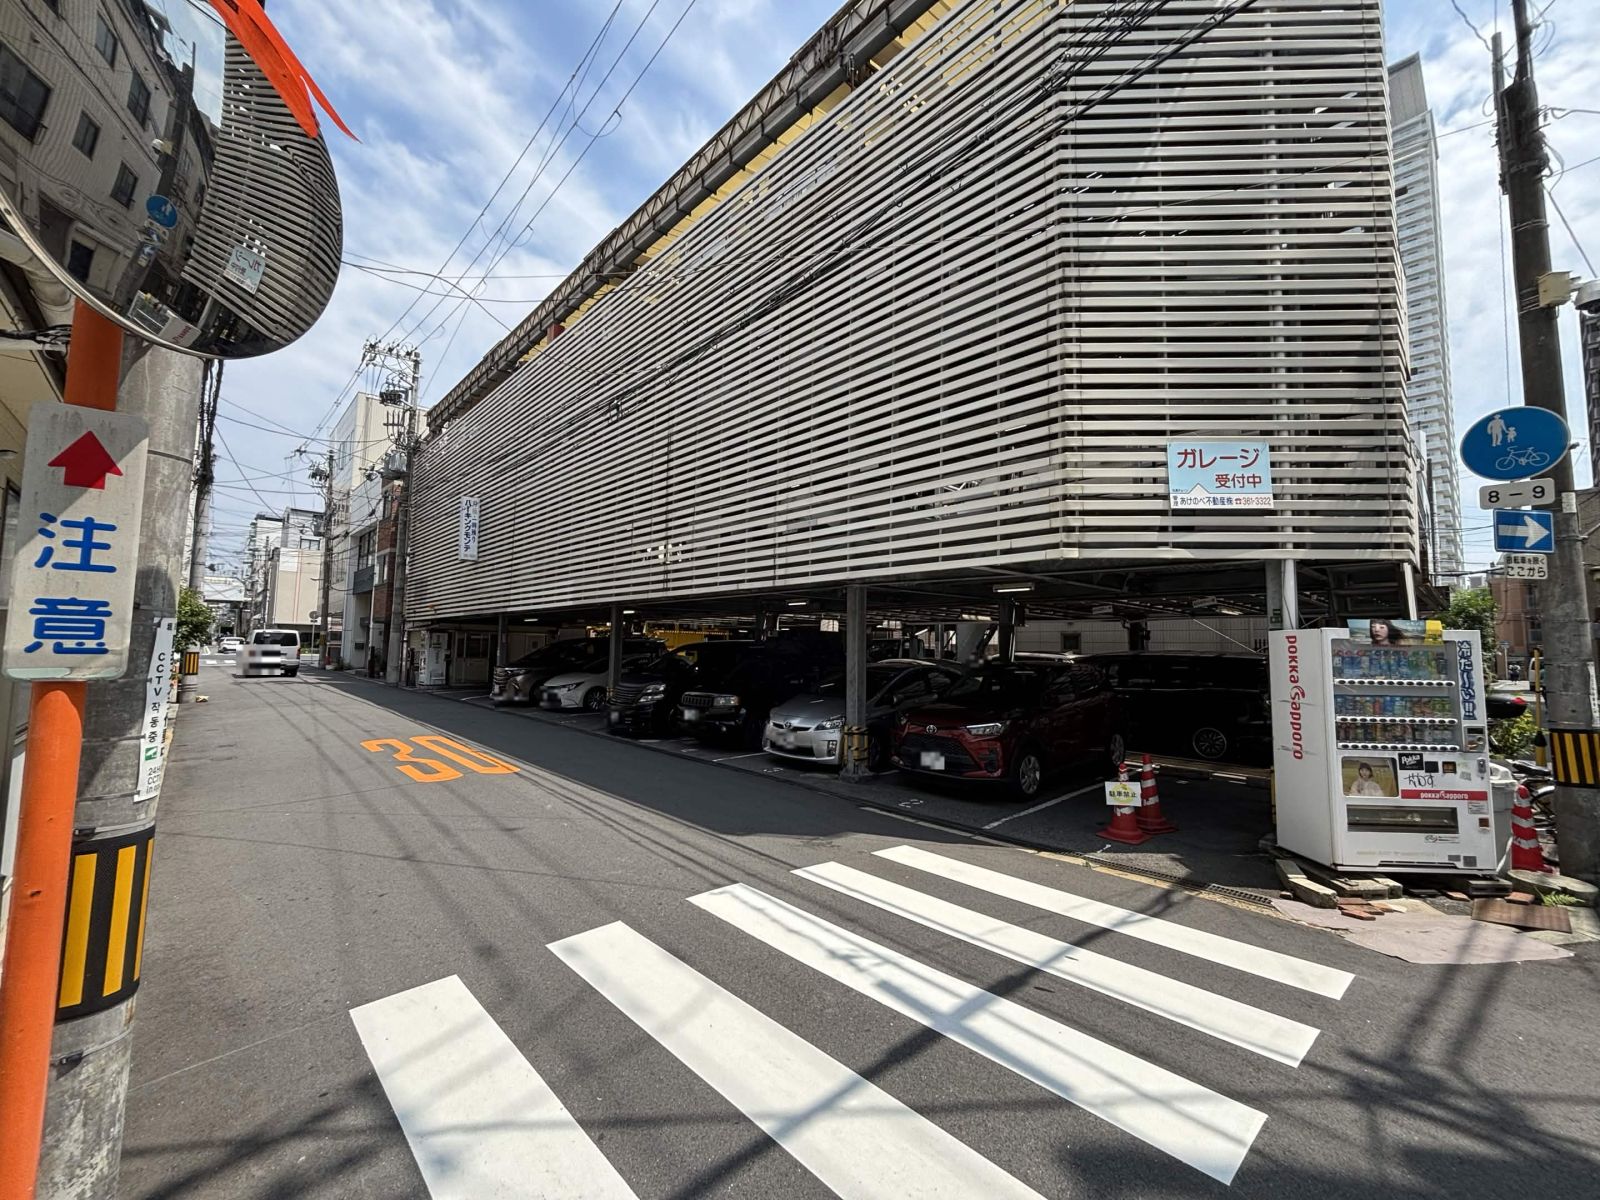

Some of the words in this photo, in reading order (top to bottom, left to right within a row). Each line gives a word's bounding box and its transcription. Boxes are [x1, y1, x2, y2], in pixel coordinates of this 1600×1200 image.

[1177, 448, 1260, 469] ガレージ
[1215, 473, 1262, 489] 受付中
[1506, 566, 1546, 577] ここから
[24, 511, 117, 656] 注意
[153, 652, 166, 697] CCTV
[360, 735, 521, 783] 30
[1109, 790, 1137, 798] 駐車禁止
